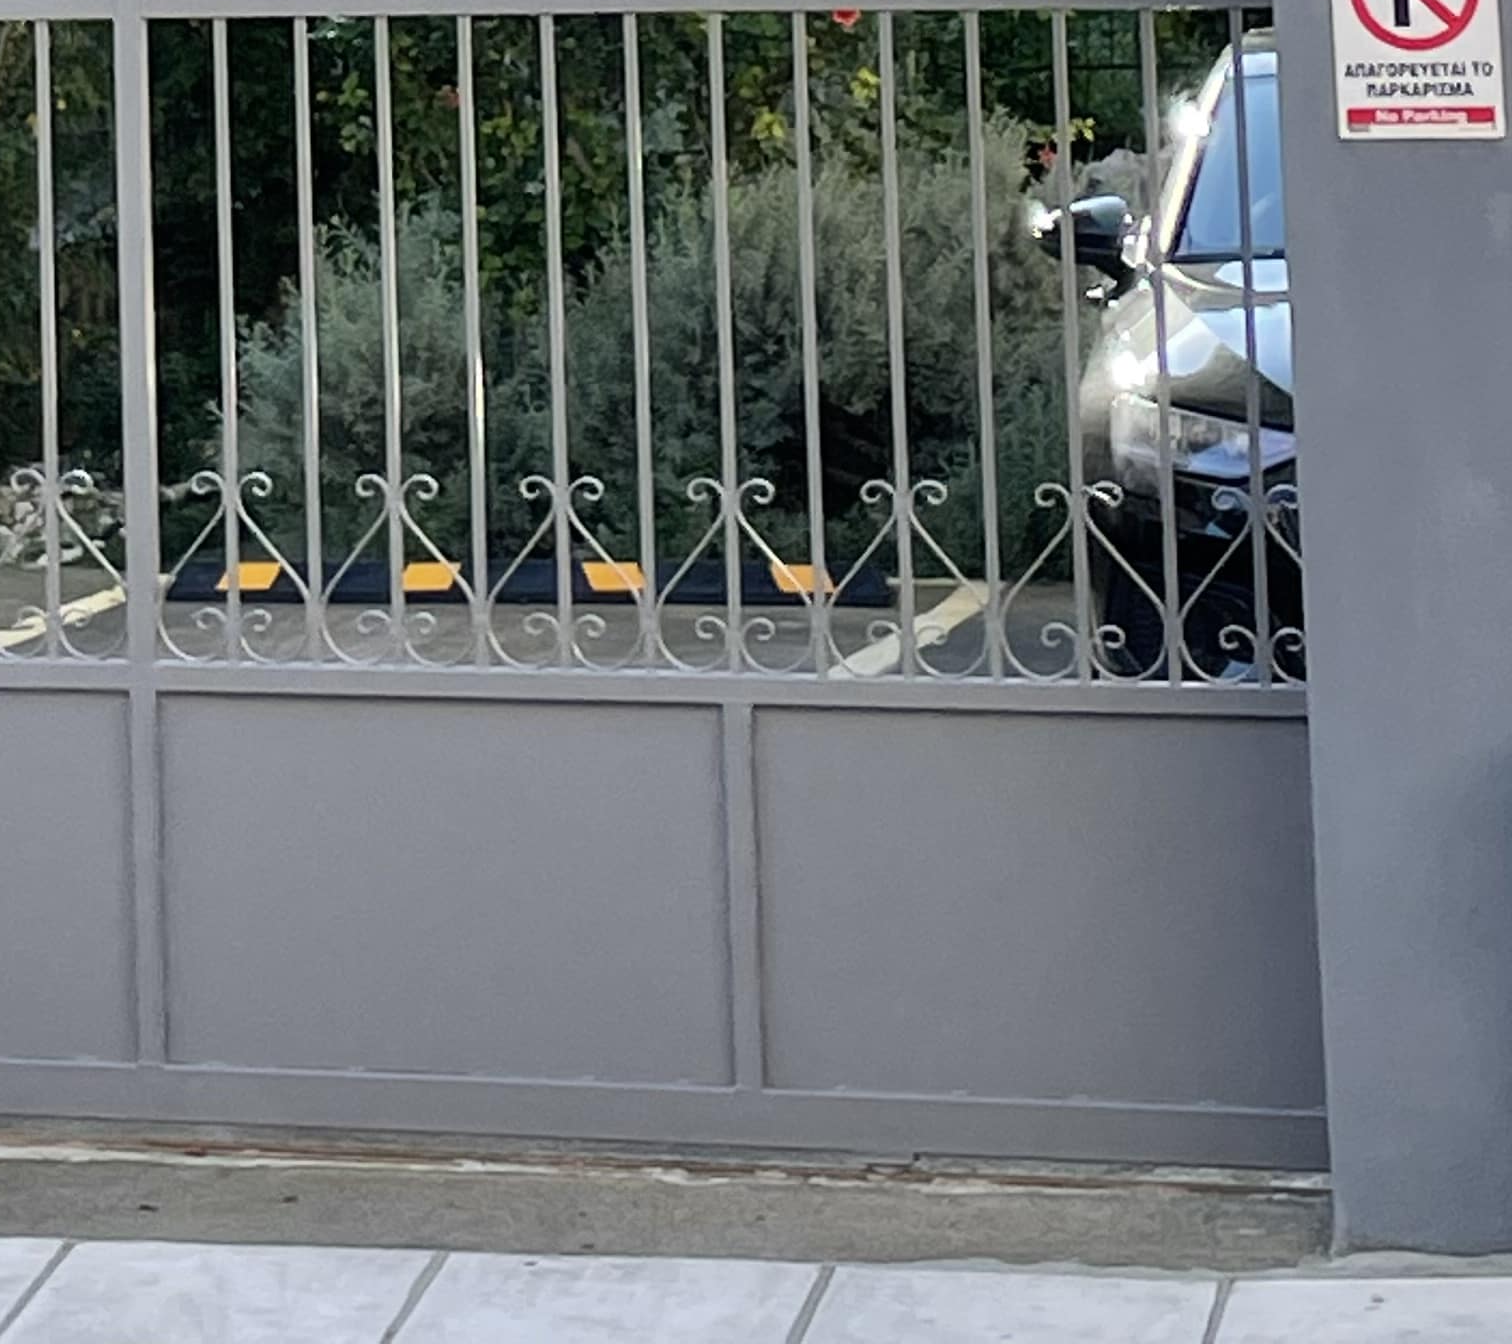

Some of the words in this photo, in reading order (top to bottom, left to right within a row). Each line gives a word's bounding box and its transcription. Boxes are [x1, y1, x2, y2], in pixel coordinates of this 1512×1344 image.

[1344, 62, 1466, 78] ΑΠΑΓΟΡΕΥΕΤΑΙ
[1471, 61, 1494, 76] ΤΟ
[1366, 82, 1474, 98] ΠΑΡΚΑΡΙΣΜΑ
[1375, 109, 1399, 123] No
[1402, 108, 1468, 123] Parking
